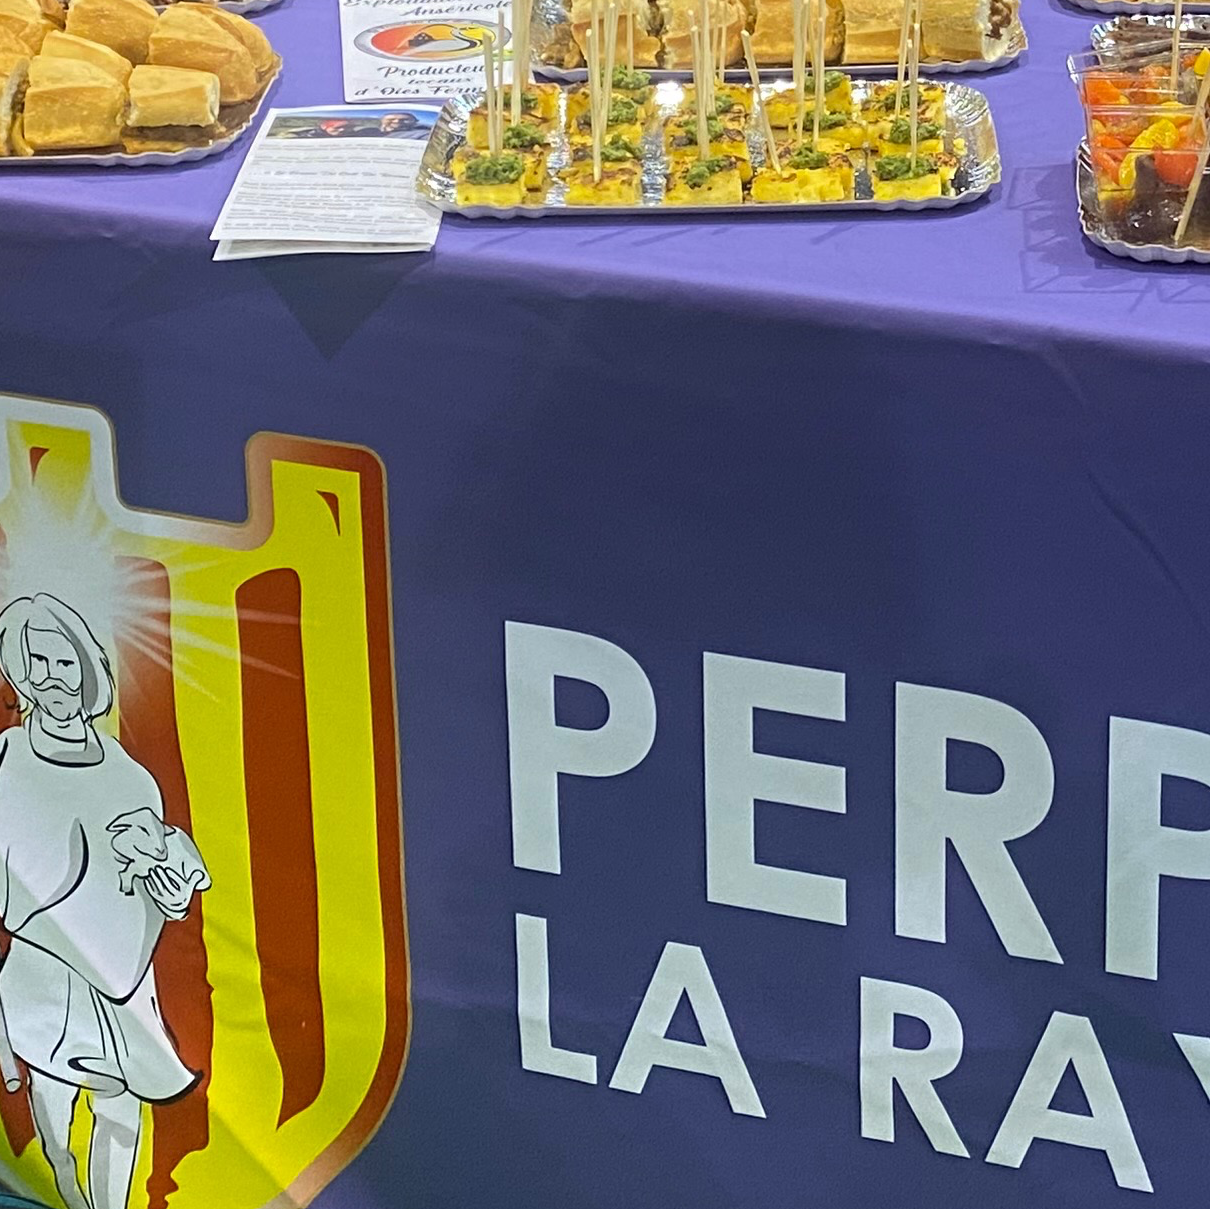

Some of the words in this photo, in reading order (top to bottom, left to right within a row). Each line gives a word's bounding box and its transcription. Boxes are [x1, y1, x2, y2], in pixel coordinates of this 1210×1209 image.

[377, 64, 499, 78] Producteu
[408, 77, 472, 85] locaux
[515, 912, 767, 1119] LA
